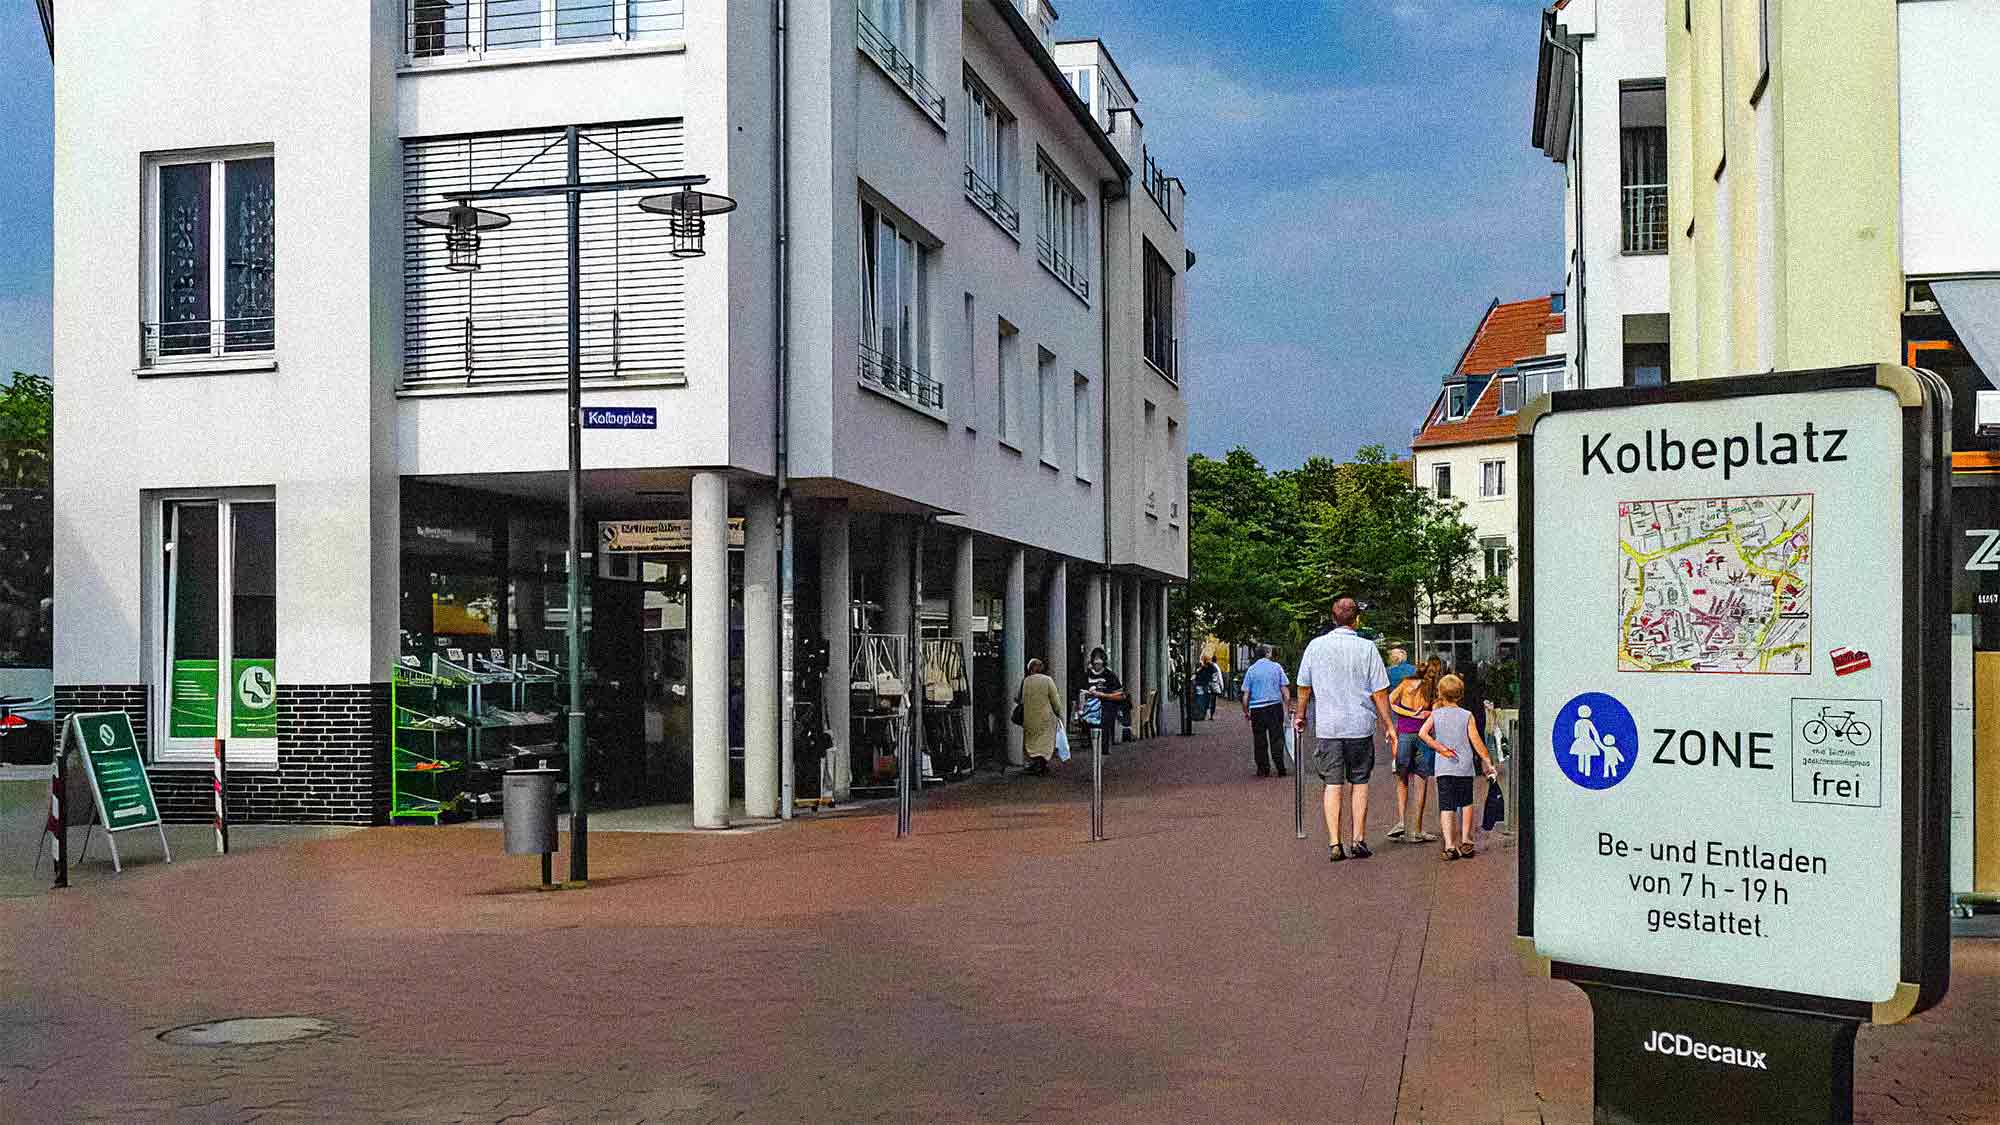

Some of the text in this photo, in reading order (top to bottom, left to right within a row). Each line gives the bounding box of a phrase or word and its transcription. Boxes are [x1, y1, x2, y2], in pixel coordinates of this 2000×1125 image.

[588, 411, 655, 427] Kolbeplatz
[1582, 421, 1849, 481] Kolbeplatz
[1651, 728, 1775, 770] ZONE
[1812, 771, 1861, 799] frei
[1650, 839, 1697, 864] und
[1706, 841, 1827, 875] Entladen
[1628, 873, 1671, 895] von
[1647, 909, 1769, 938] gestattet.
[1643, 1030, 1768, 1070] JCDecaux
